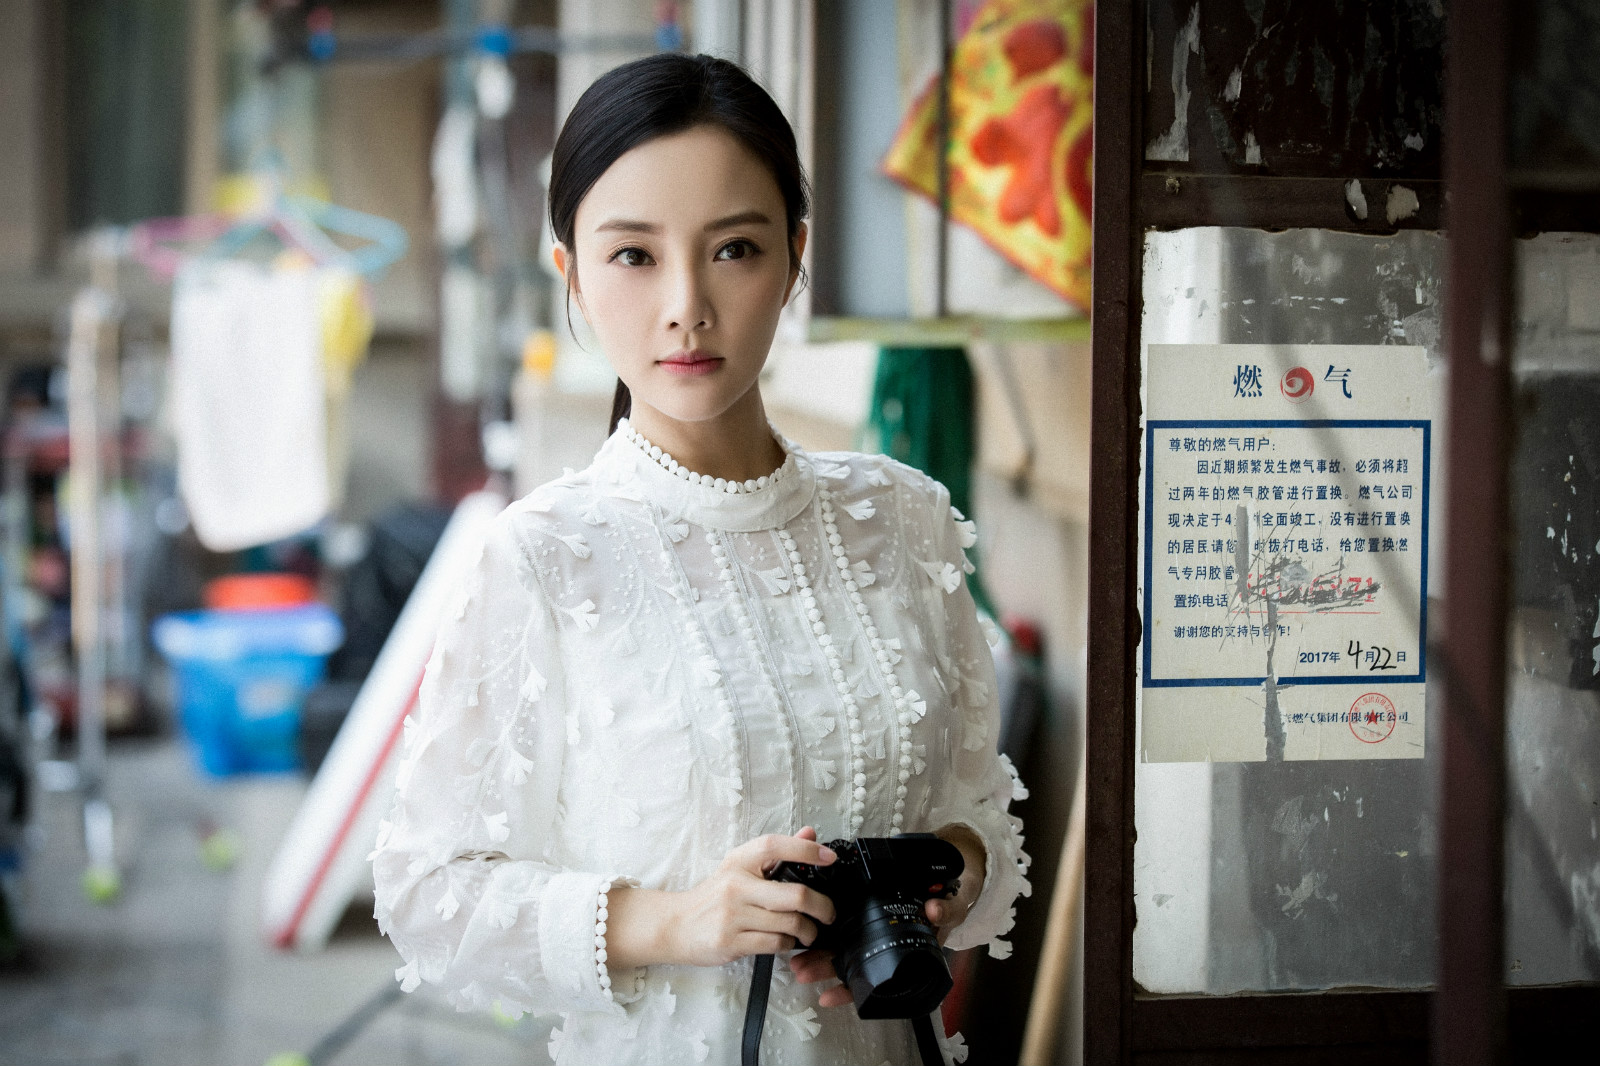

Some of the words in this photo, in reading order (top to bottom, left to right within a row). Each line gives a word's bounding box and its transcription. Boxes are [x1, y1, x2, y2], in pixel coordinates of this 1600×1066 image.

[1234, 364, 1263, 398] 燃
[1324, 364, 1353, 399] 气
[1169, 437, 1276, 452] 尊敬的燃气用户：
[1174, 593, 1229, 609] 置换电话
